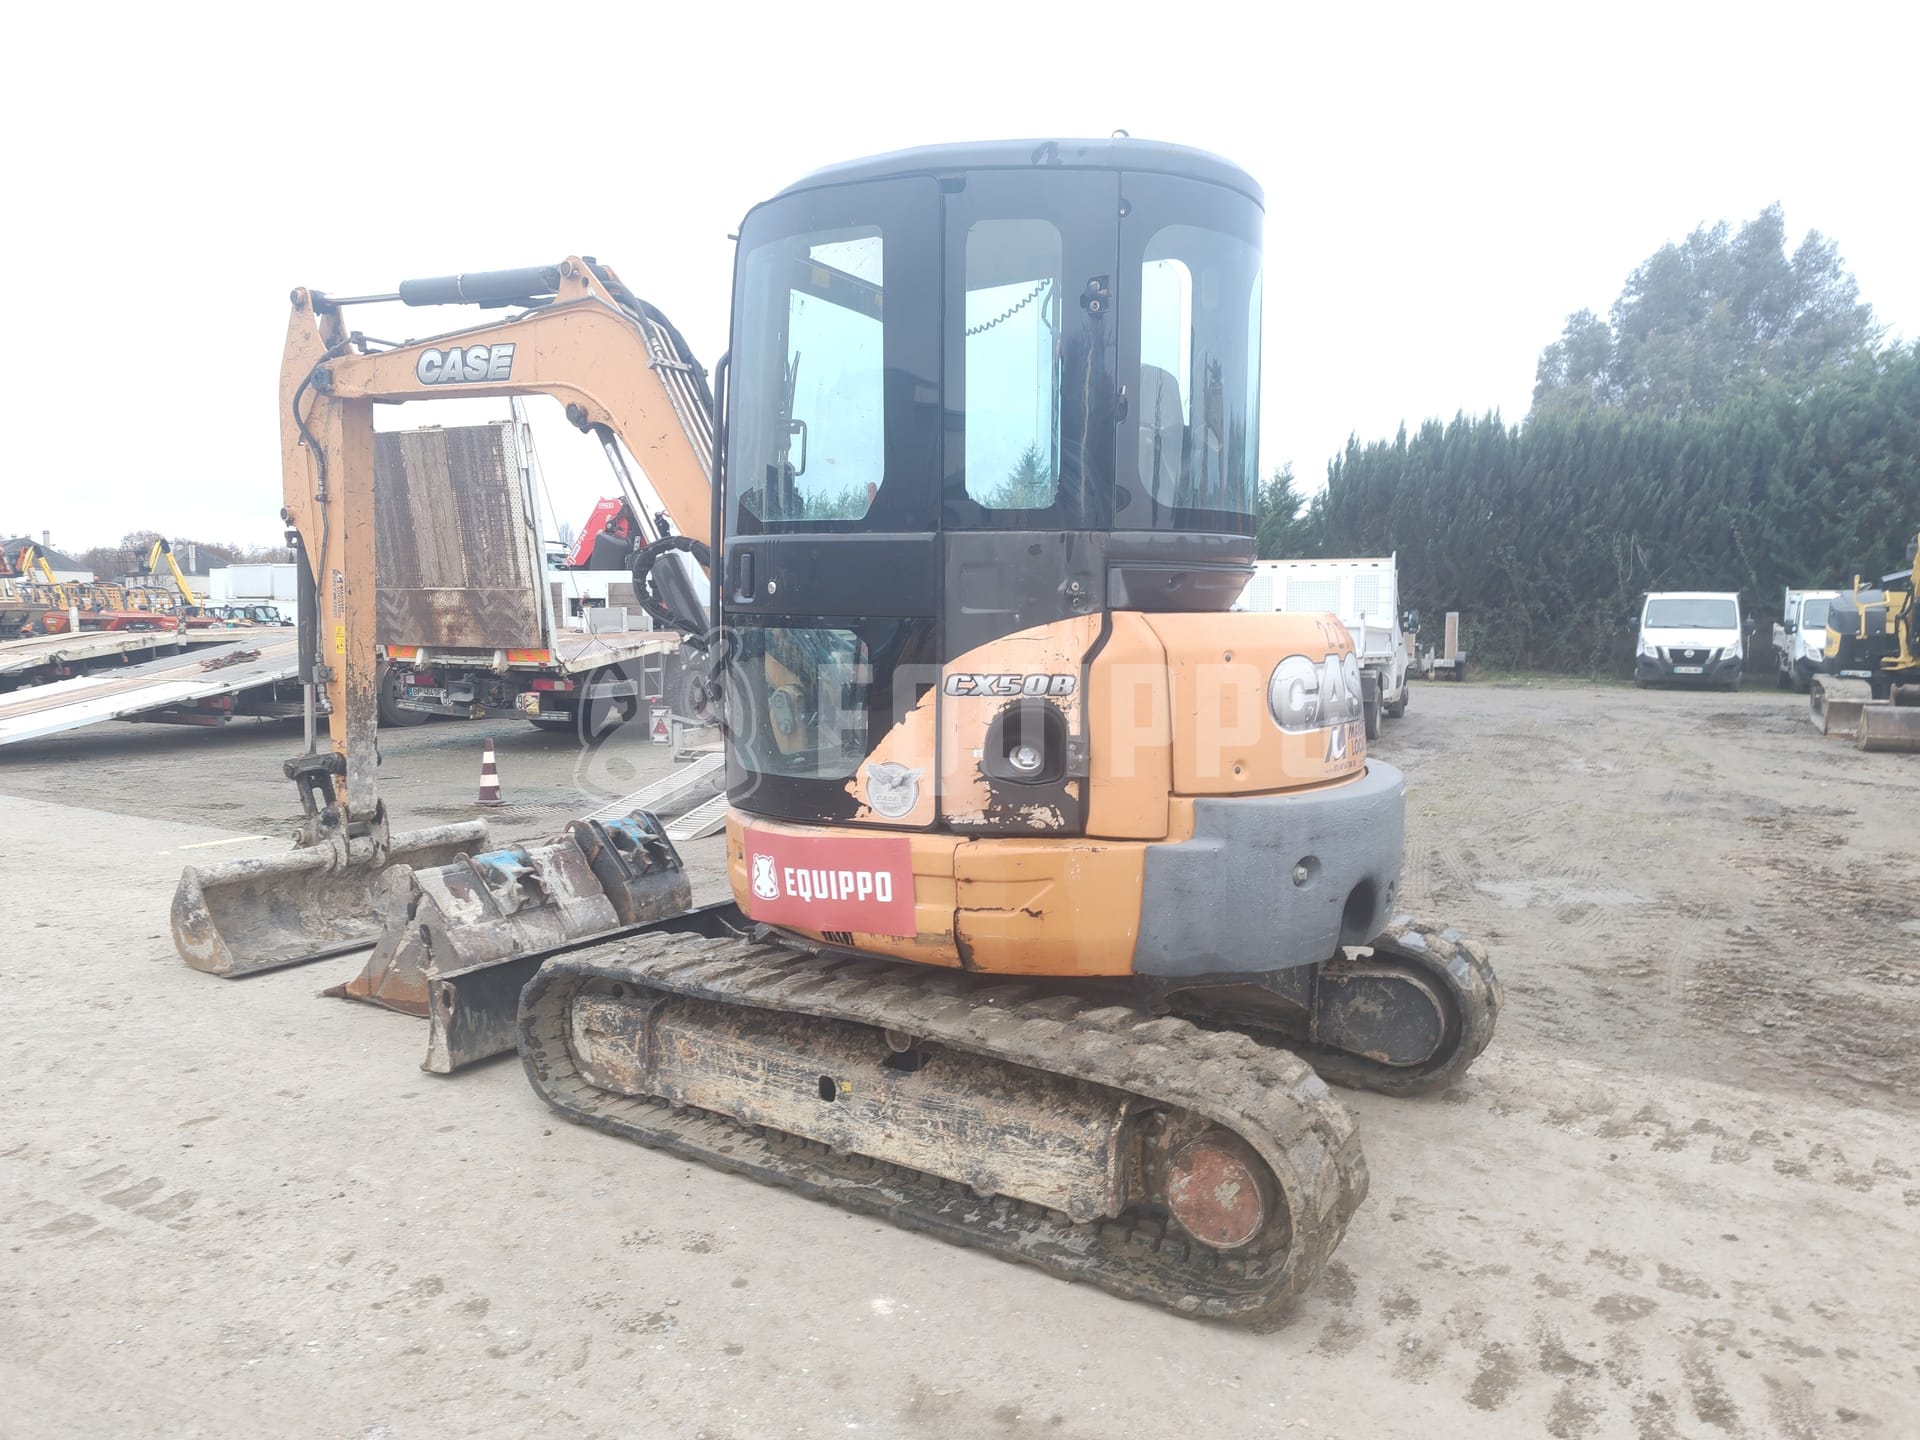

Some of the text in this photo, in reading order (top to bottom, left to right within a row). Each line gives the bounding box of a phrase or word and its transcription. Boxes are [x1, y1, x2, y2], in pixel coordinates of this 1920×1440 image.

[417, 343, 516, 385] CASE
[944, 673, 1076, 697] CX50B
[784, 867, 893, 902] EQUIPPO
